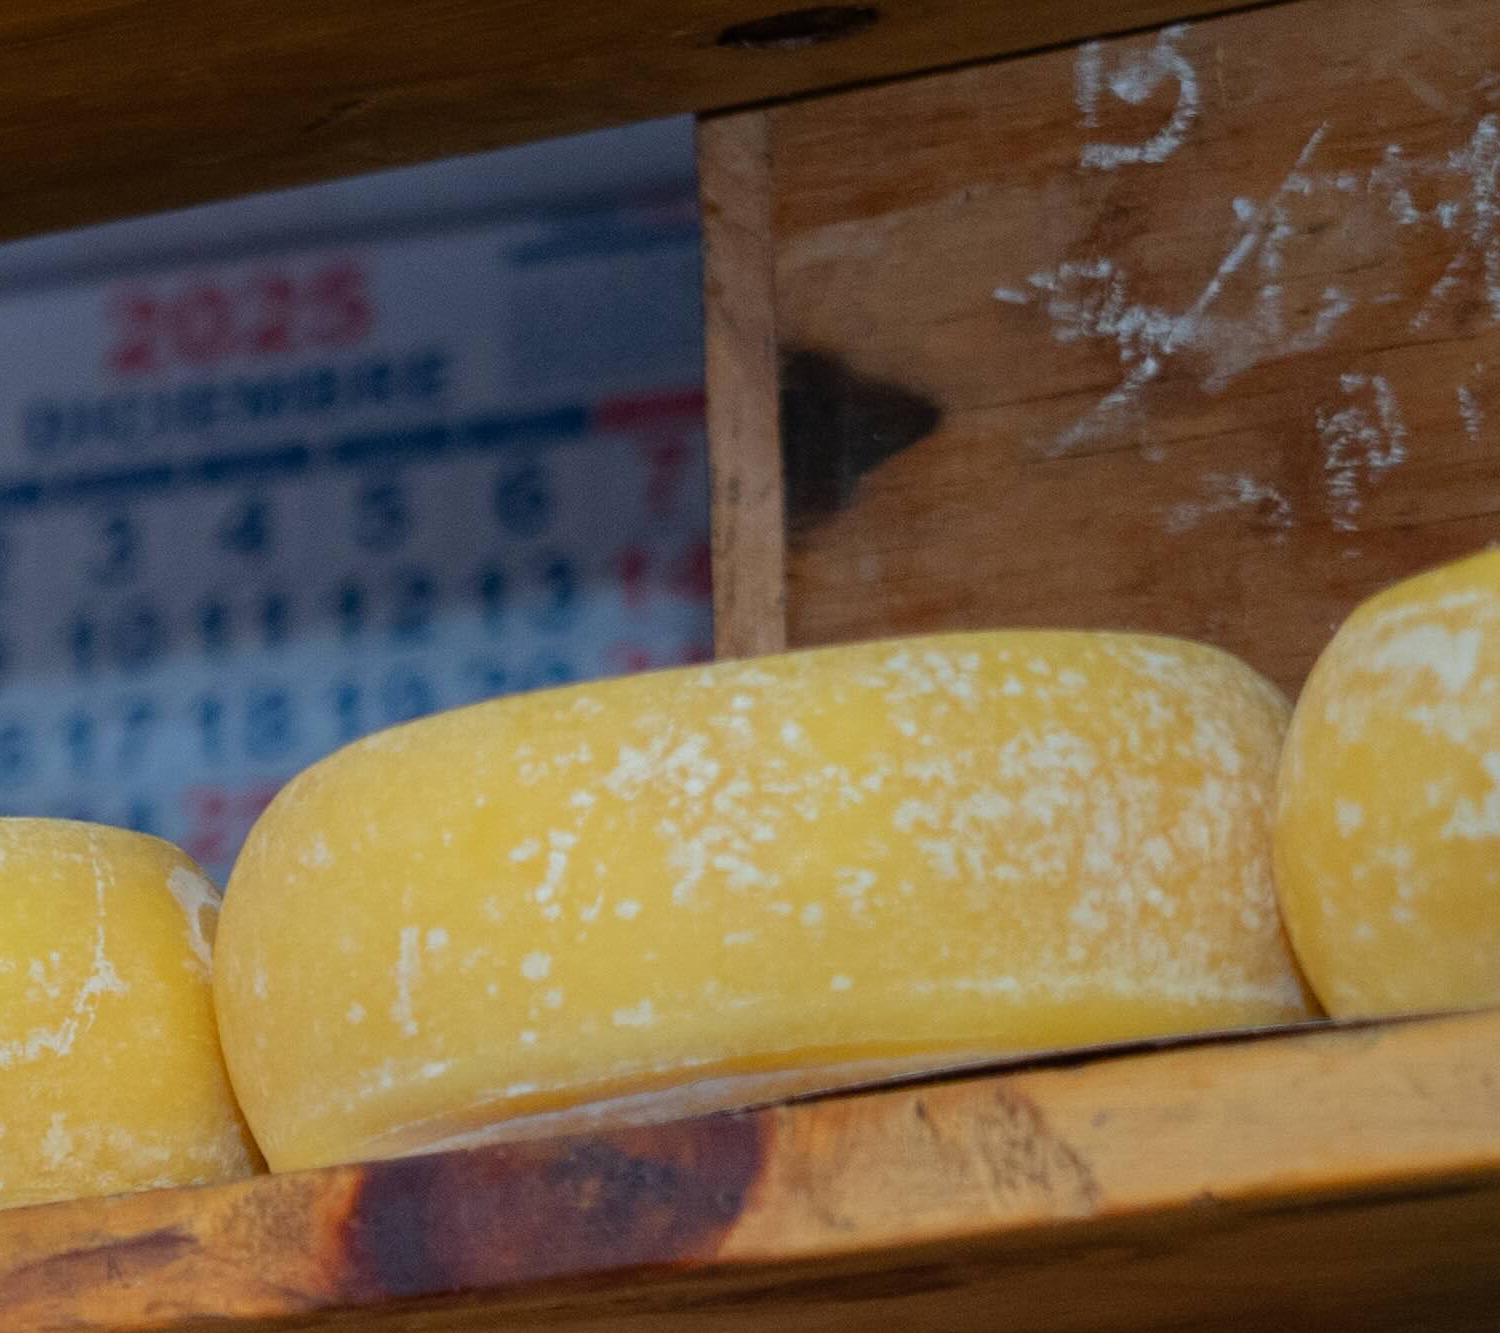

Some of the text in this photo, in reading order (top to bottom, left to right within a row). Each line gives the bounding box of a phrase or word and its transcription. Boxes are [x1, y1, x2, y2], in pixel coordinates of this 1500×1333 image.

[108, 256, 370, 380] 2025
[20, 350, 450, 454] DICIEMBRE
[96, 512, 140, 584] 3
[217, 494, 271, 558] 4
[356, 479, 412, 553] 5
[493, 463, 553, 538] 6
[68, 600, 164, 680] 10
[196, 584, 290, 658] 11
[333, 566, 438, 640] 12
[474, 550, 578, 630] 13
